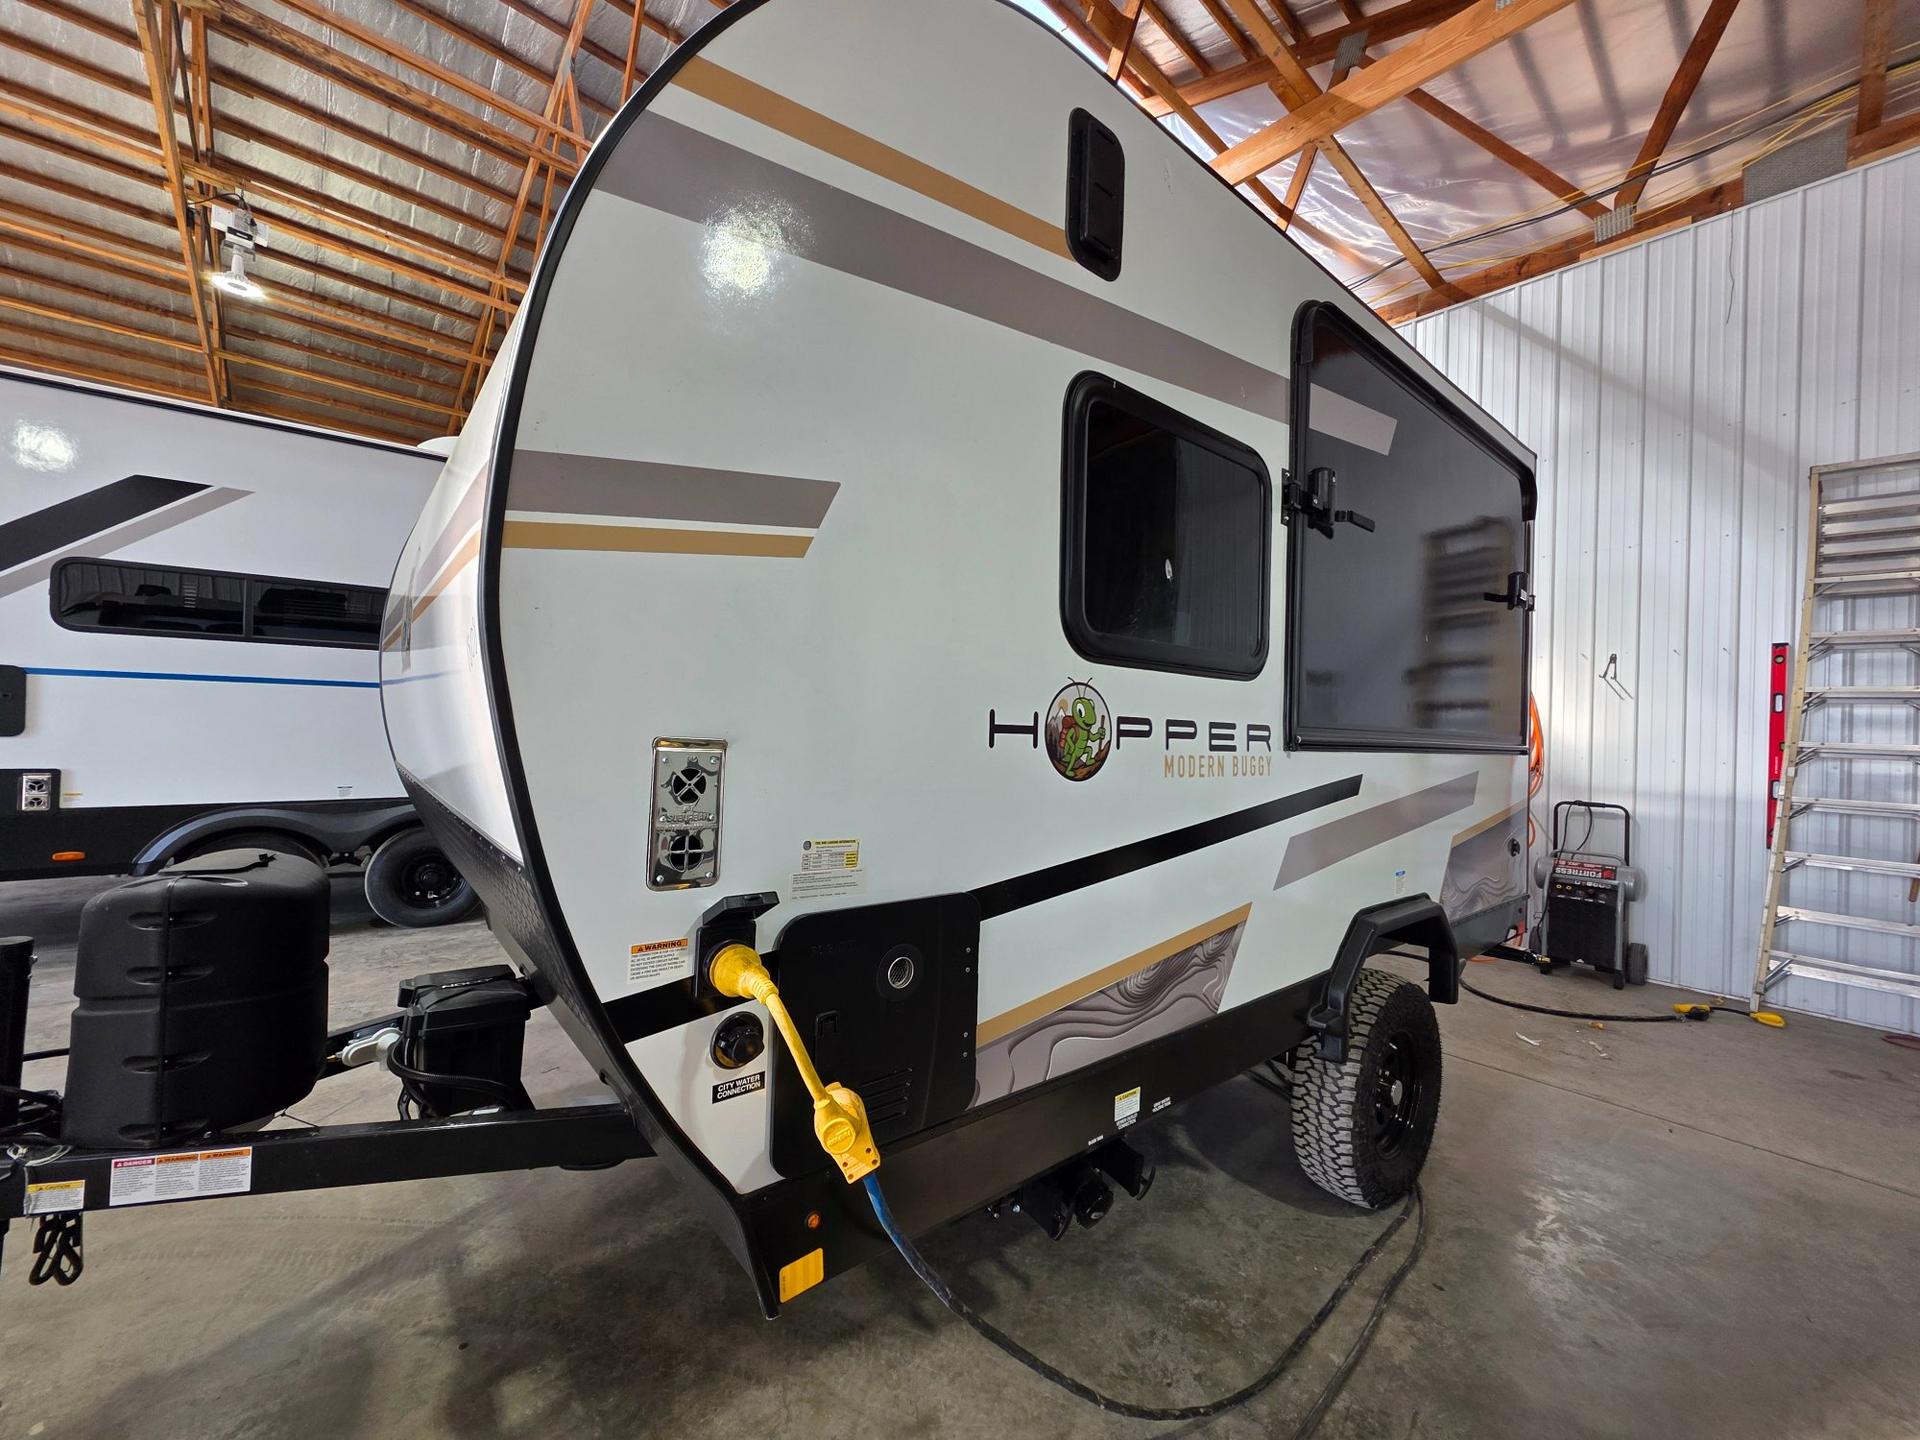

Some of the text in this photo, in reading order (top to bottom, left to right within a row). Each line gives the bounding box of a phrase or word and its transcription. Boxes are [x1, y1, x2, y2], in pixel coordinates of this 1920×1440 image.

[1164, 755, 1272, 778] MODERN BUGGY
[1554, 867, 1603, 879] FORTRESS
[644, 940, 682, 951] WARNING
[717, 1074, 760, 1092] CITY WATER
[717, 1080, 761, 1099] CONNECTION
[212, 1150, 244, 1158] WARNING
[123, 1159, 153, 1167] DANGER
